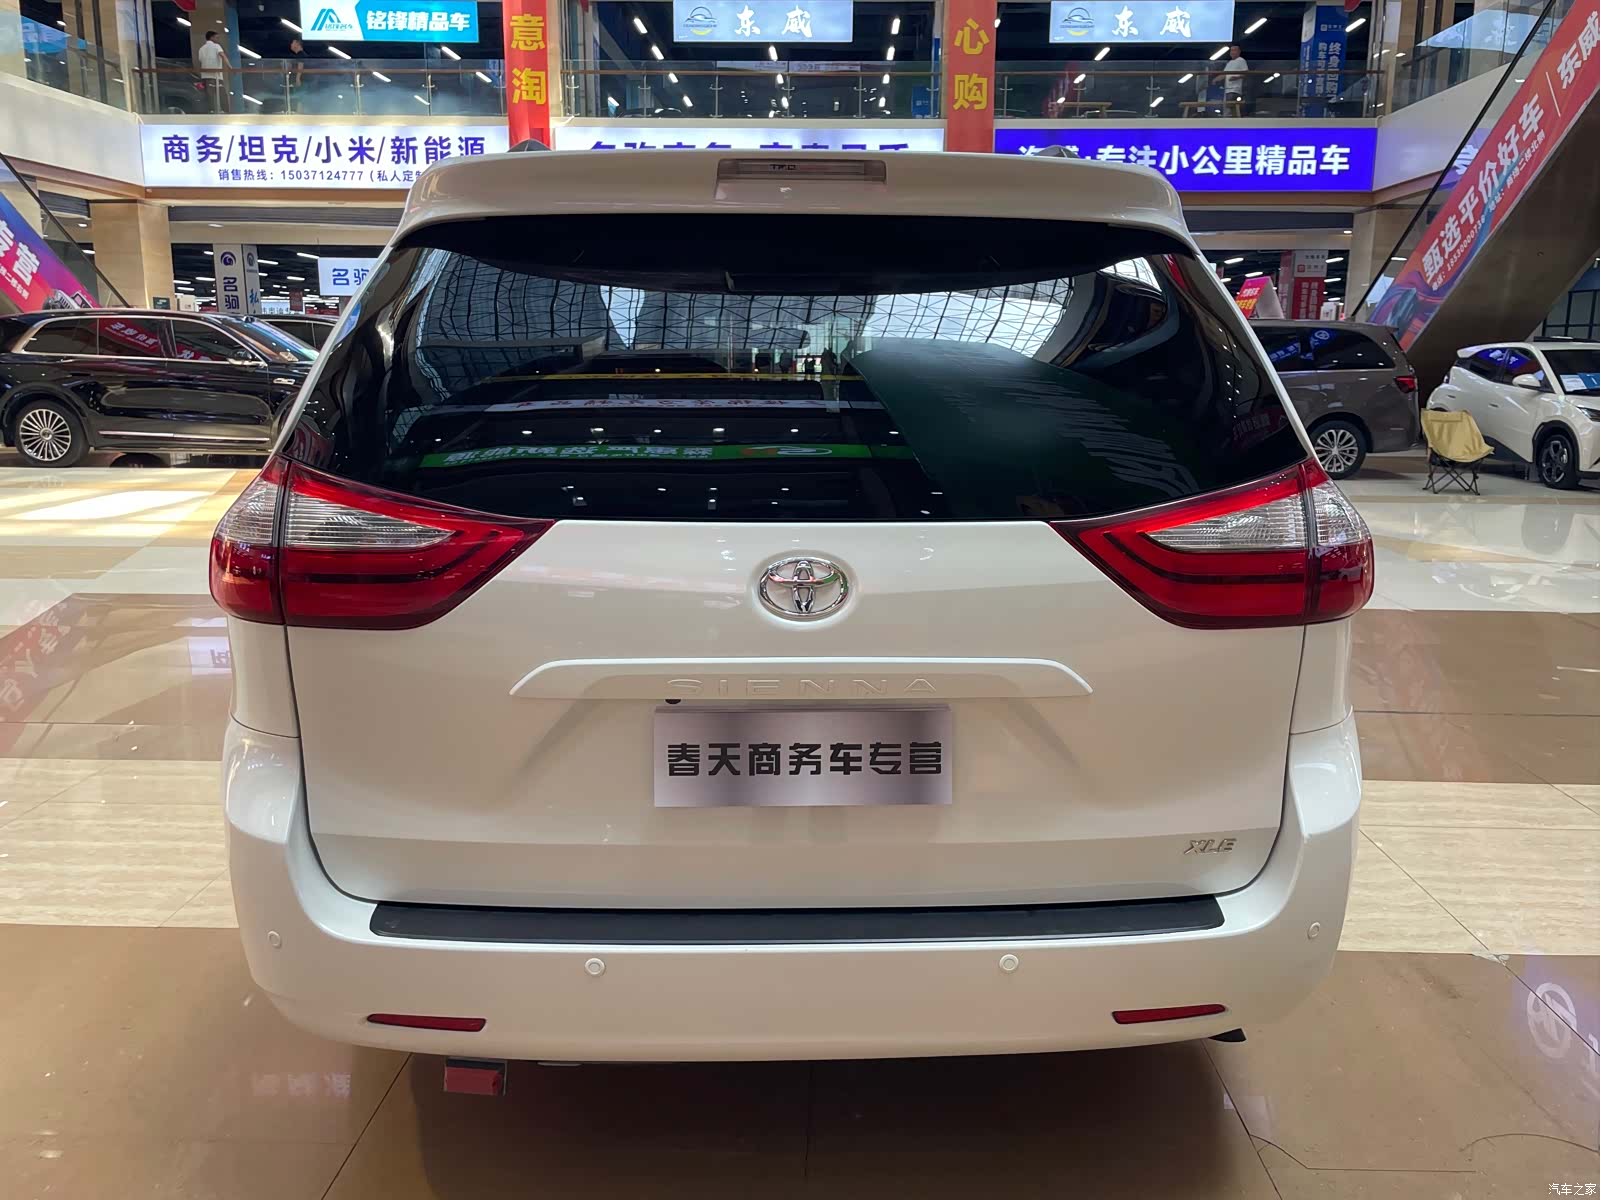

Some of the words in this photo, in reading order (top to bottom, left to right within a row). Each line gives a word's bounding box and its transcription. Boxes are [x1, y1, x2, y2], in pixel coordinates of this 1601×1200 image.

[366, 10, 471, 31] 铭锋精品车
[734, 5, 812, 37] 东威
[1112, 5, 1191, 38] 东威
[510, 13, 546, 105] 意淘
[954, 17, 990, 110] 心购
[667, 678, 937, 696] SIENNA
[667, 741, 943, 776] 春天商务车专营
[1184, 838, 1237, 854] XLE
